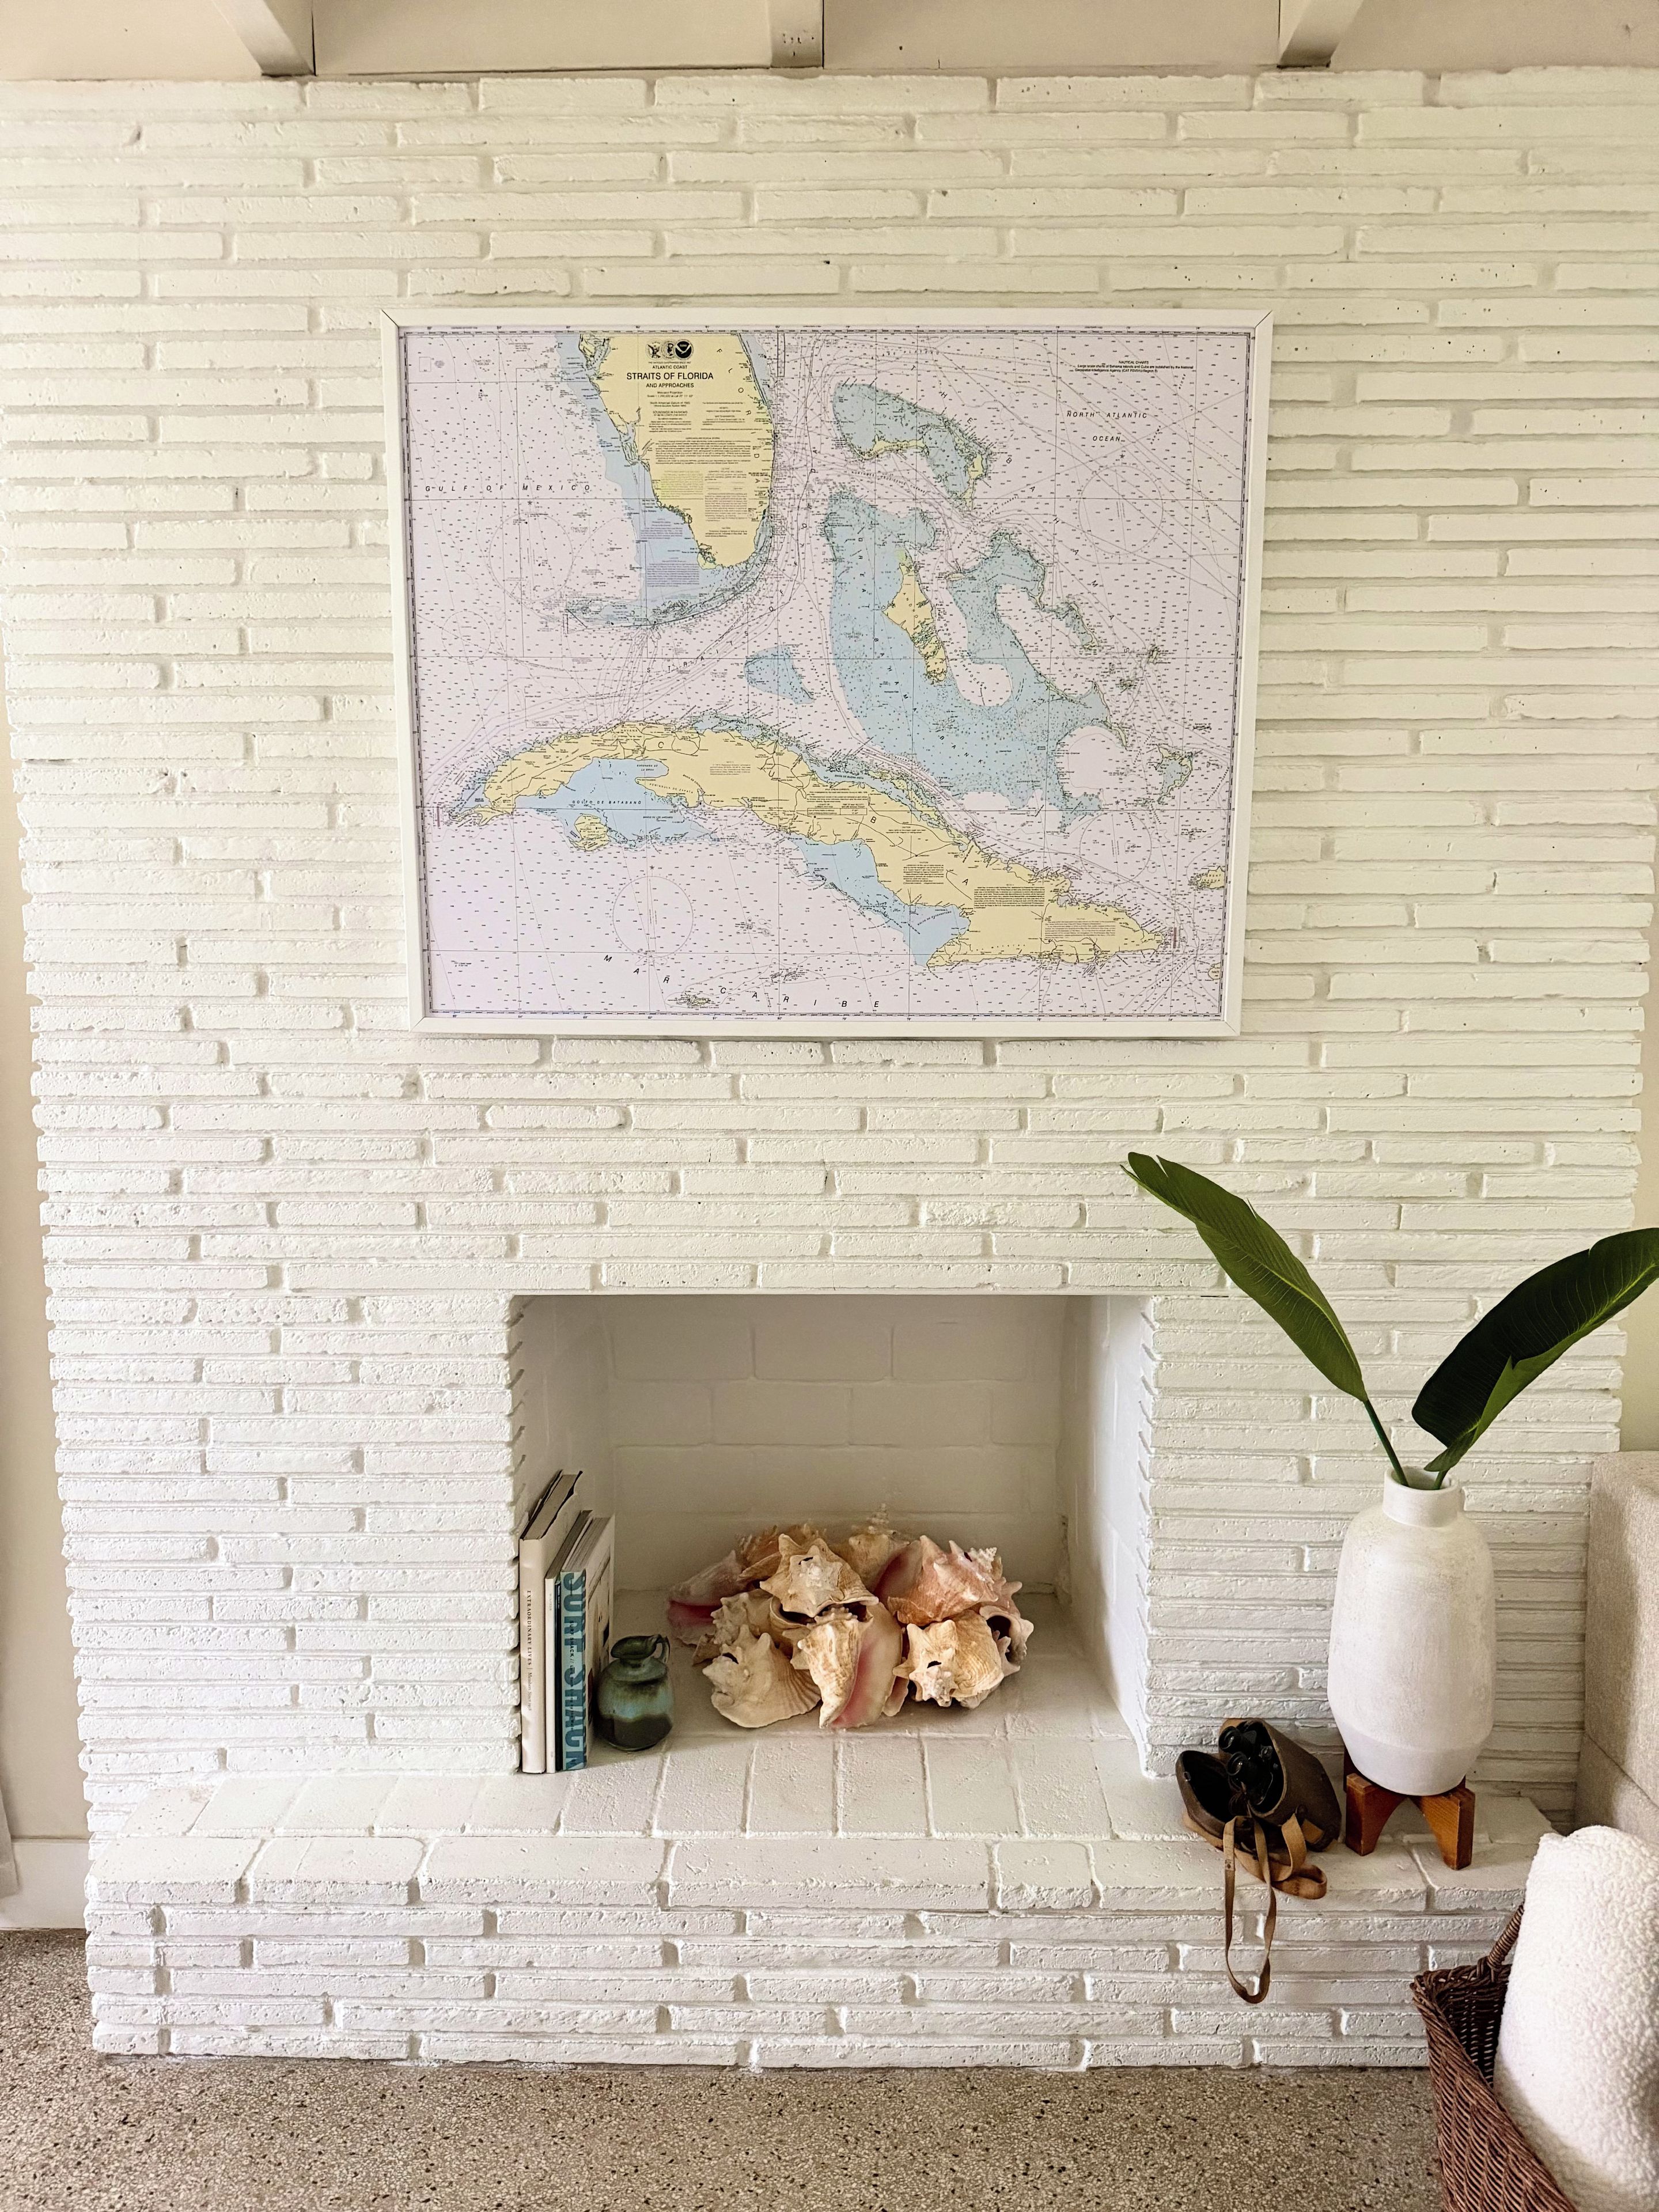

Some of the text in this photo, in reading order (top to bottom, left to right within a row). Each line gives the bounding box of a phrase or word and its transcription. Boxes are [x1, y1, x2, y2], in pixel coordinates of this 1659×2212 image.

[627, 372, 661, 380] STRAITS
[664, 372, 676, 380] OF
[563, 1569, 586, 1771] SURF SHACK
